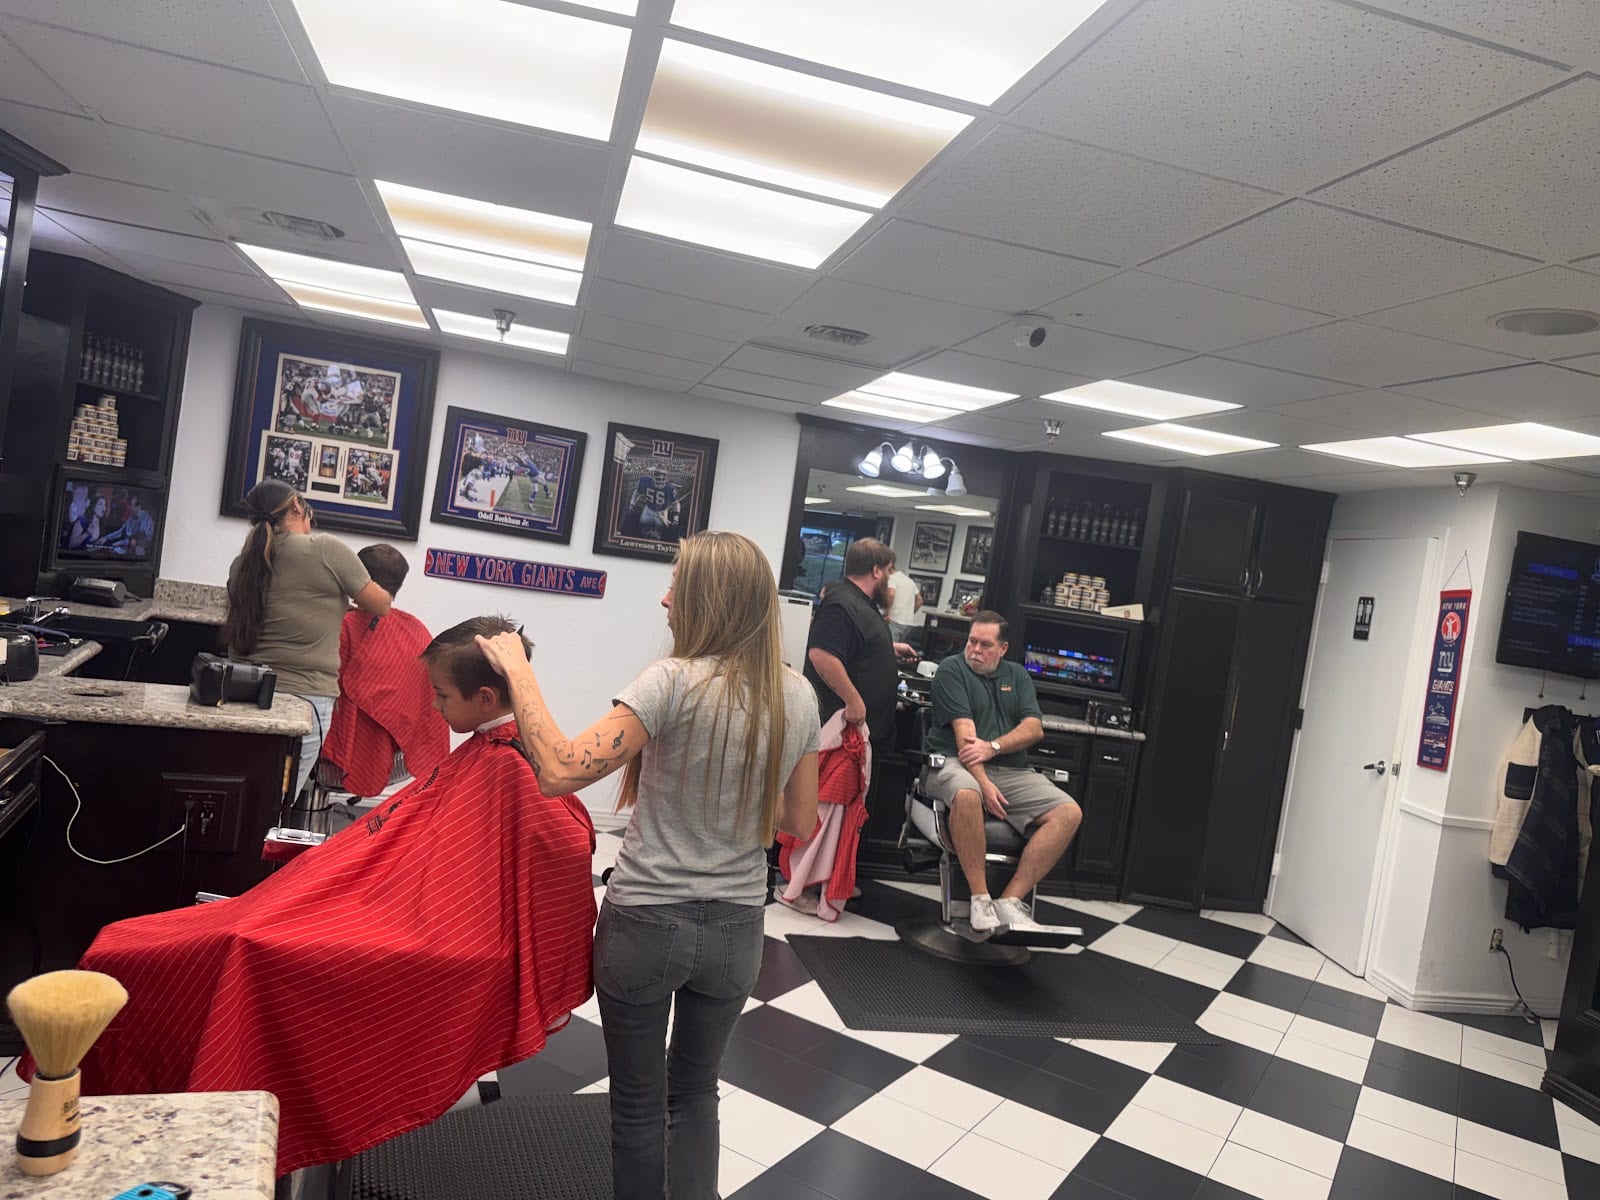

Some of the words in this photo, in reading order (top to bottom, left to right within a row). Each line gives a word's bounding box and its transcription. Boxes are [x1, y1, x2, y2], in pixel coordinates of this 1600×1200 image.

[646, 488, 665, 505] 56
[478, 511, 494, 521] Odell
[494, 513, 521, 526] Beckham
[620, 539, 655, 551] Lawrence
[435, 551, 470, 577] NEW
[475, 556, 517, 584] YORK
[521, 563, 576, 591] GIANTS
[579, 576, 599, 590] AVE
[1431, 679, 1455, 694] GIANTS
